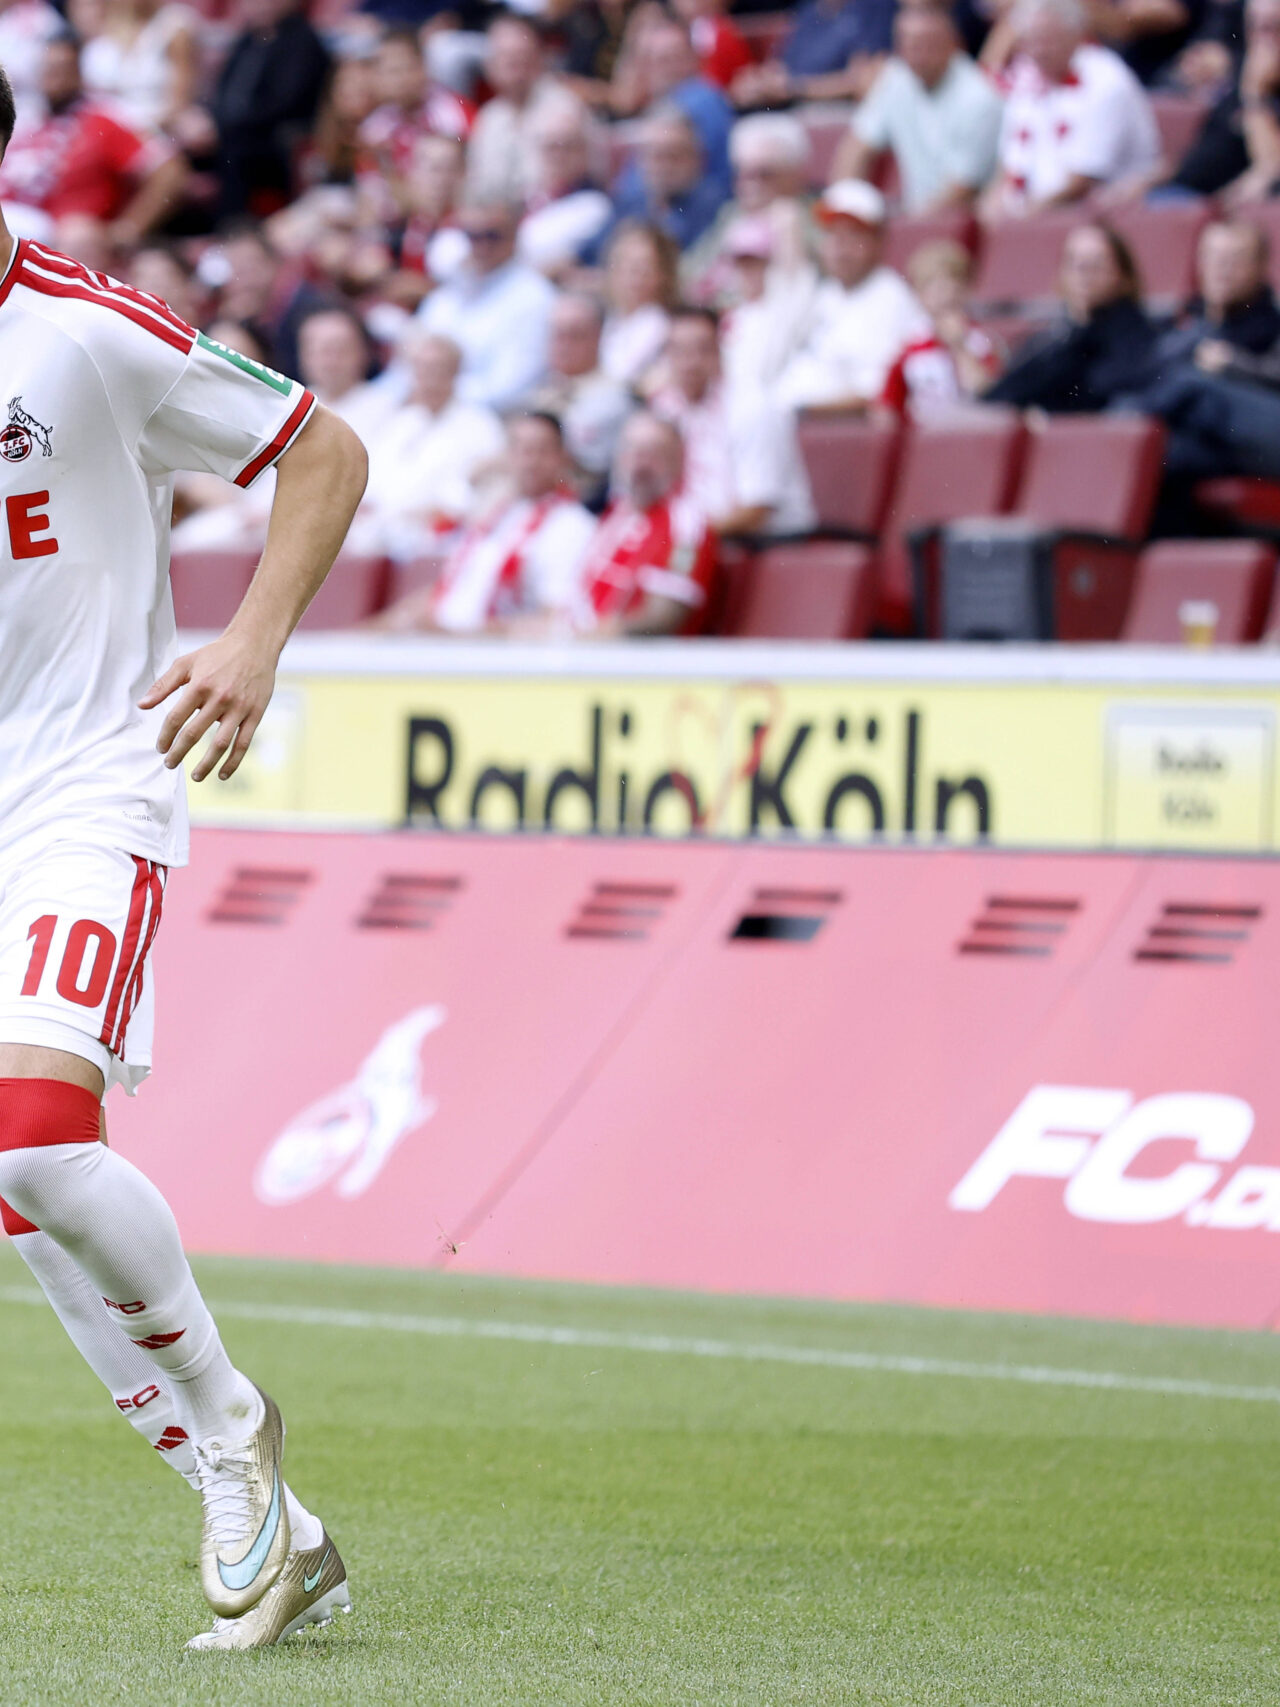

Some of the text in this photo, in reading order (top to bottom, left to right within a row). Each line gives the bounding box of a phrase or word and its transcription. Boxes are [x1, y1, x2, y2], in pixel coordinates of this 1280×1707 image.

[406, 702, 702, 832] Radio
[747, 707, 991, 840] Köln
[20, 914, 117, 1008] 10
